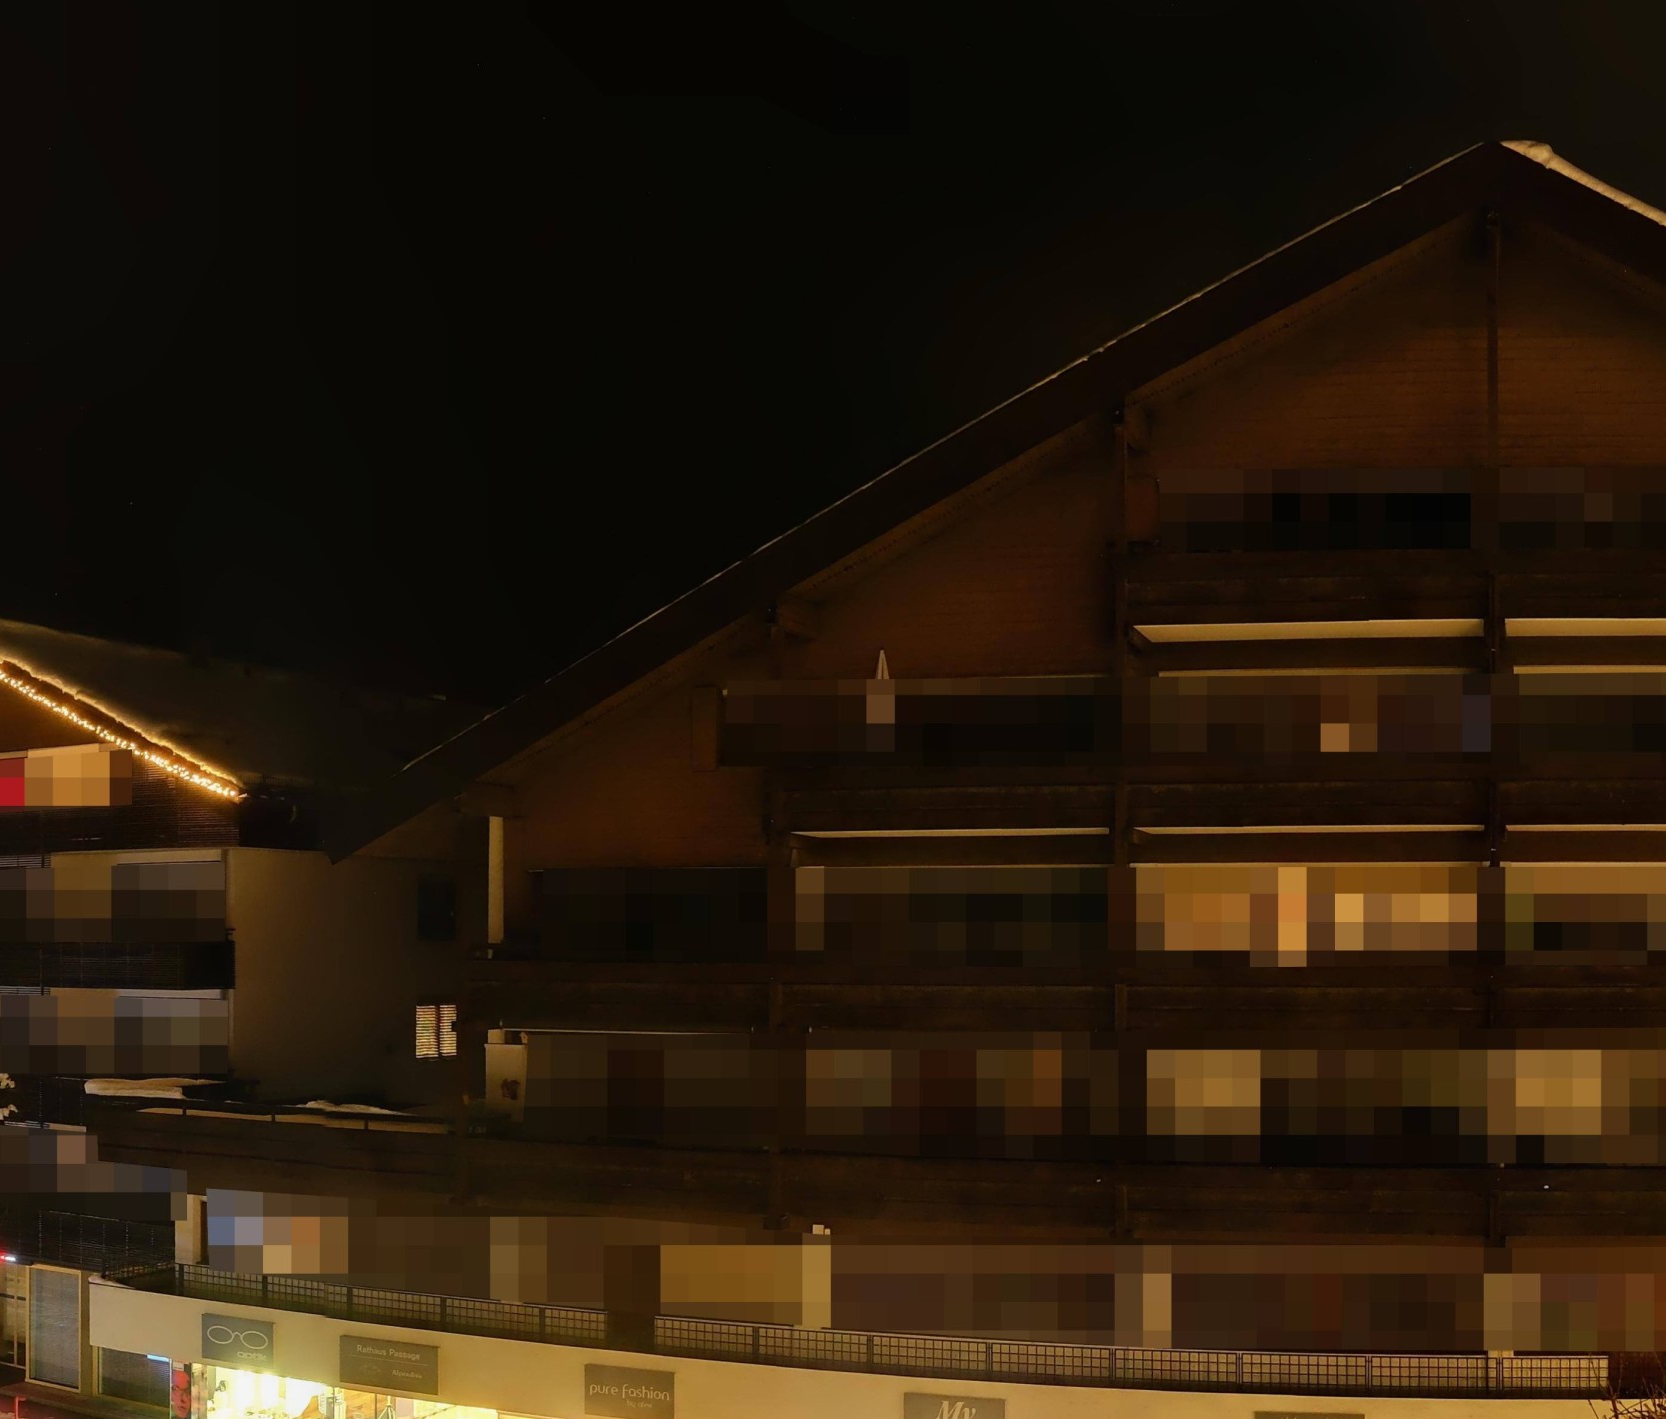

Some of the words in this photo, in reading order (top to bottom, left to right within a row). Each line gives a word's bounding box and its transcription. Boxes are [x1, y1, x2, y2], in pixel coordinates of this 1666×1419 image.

[356, 1344, 386, 1356] Rathaus
[388, 1348, 421, 1361] Passage
[589, 1383, 619, 1396] pure
[622, 1383, 670, 1401] fashion
